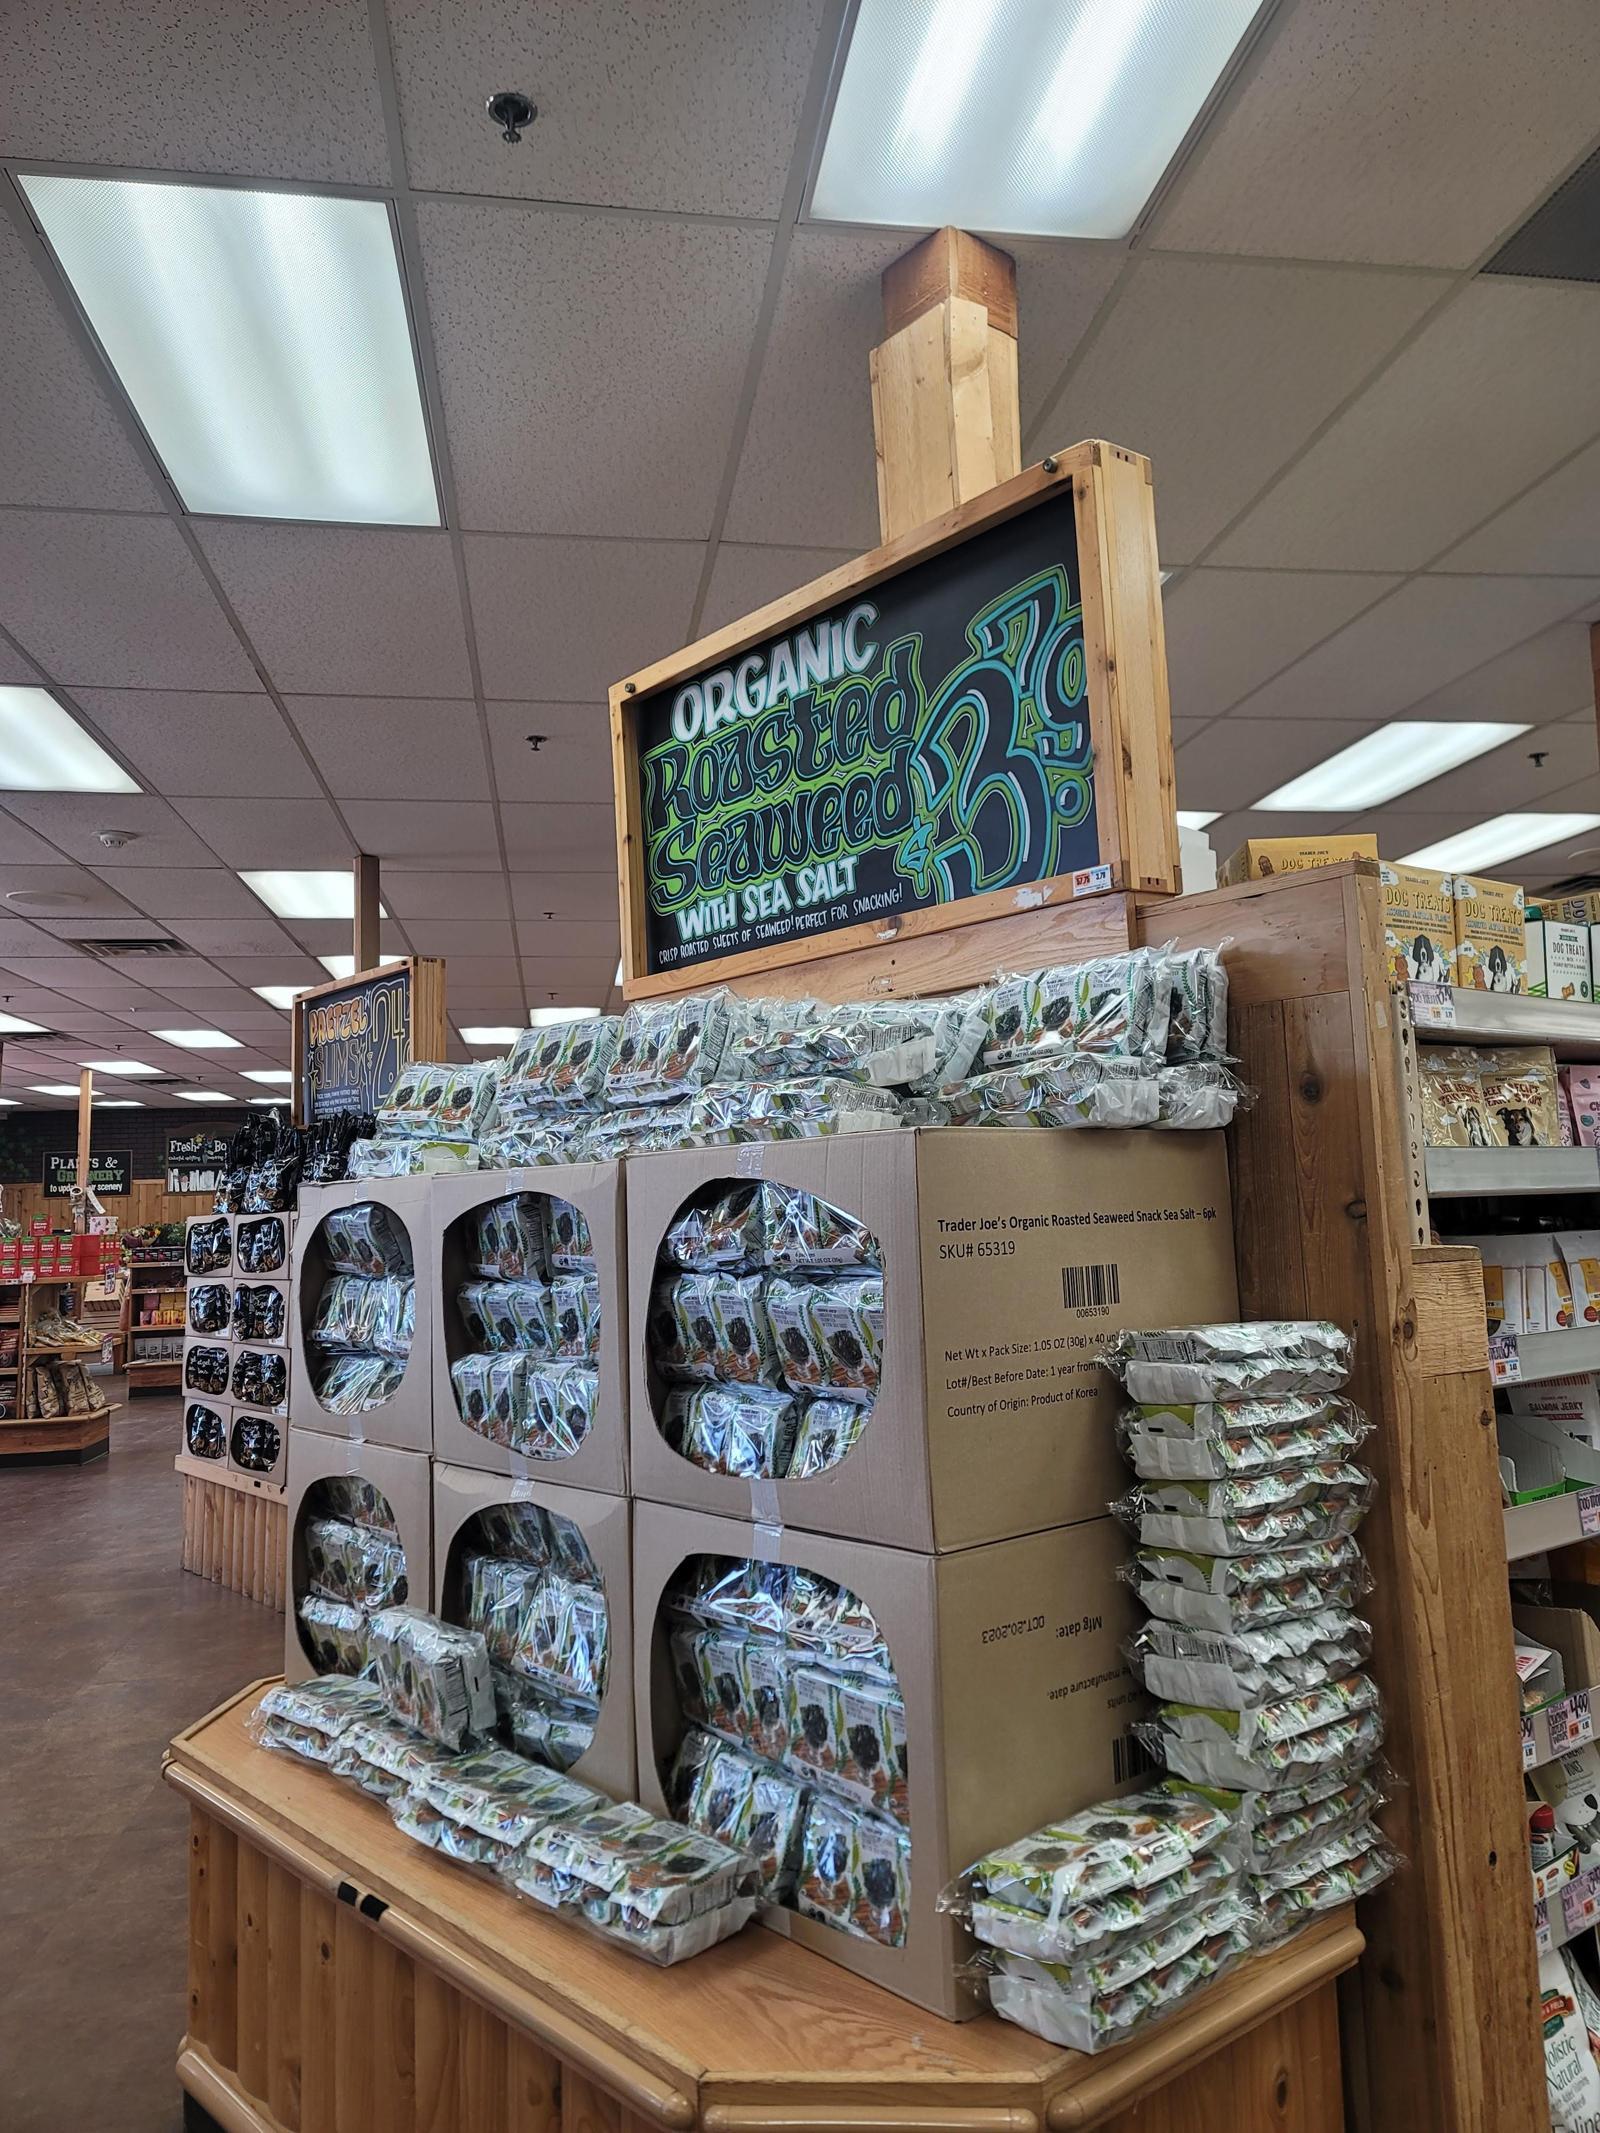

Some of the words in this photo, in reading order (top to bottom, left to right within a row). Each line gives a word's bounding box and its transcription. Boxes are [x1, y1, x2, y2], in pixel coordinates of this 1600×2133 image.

[670, 600, 880, 742] ORGANIC
[648, 640, 919, 833] Roasted
[654, 743, 914, 906] Seaweed
[675, 889, 737, 943] WITH
[743, 878, 792, 923] SEA
[797, 854, 859, 908] SALT
[1386, 887, 1408, 906] DOG
[1413, 892, 1451, 913] TREATS
[658, 947, 680, 965] CRISP
[680, 943, 709, 960] ROASTED
[713, 930, 739, 950] SHEETS
[741, 929, 751, 942] OF
[755, 919, 795, 939] SEAWEED!
[795, 911, 827, 930] PERFECT
[831, 904, 848, 921] FOR
[853, 882, 903, 916] SNACKING!
[1465, 900, 1486, 918] DOG
[1490, 904, 1522, 926] TREATS
[1552, 942, 1564, 954] DOG
[1565, 943, 1585, 957] TREATS
[308, 996, 369, 1048] PRETZEL
[316, 1038, 362, 1089] SLIMS
[170, 1138, 197, 1153] Fresh
[50, 1156, 99, 1169] PLAS
[105, 1156, 118, 1169] &
[57, 1169, 125, 1182] GRNERY
[49, 1184, 58, 1193] to
[97, 1183, 123, 1193] scenery
[938, 1218, 976, 1232] Trader
[980, 1216, 1007, 1230] Joe's
[1009, 1214, 1049, 1231] Organic
[1051, 1212, 1090, 1226] Roasted
[1093, 1210, 1134, 1224] Seaweed
[1137, 1208, 1162, 1222] Snack
[1163, 1208, 1179, 1221] Sea
[1180, 1207, 1195, 1220] Salt
[1203, 1207, 1217, 1221] 6pk
[939, 1243, 973, 1260] SKU#
[977, 1240, 1016, 1257] 65319
[1076, 1306, 1110, 1319] 00653190
[944, 1349, 962, 1362] Net
[964, 1348, 980, 1360] Wt
[981, 1350, 987, 1358] x
[989, 1345, 1010, 1357] Pack
[1011, 1342, 1032, 1354] Size:
[1034, 1340, 1051, 1352] 1.05
[1053, 1338, 1065, 1350] OZ
[1067, 1334, 1087, 1350] (30g)
[1095, 1333, 1105, 1344] 40
[946, 1374, 996, 1390] Lot#/Best
[994, 1370, 1024, 1384] Before
[1026, 1368, 1049, 1380] Date:
[1051, 1366, 1056, 1377] 1
[1057, 1364, 1075, 1380] year
[1077, 1361, 1100, 1374] from
[947, 1404, 985, 1418] Country
[987, 1401, 998, 1413] of
[999, 1397, 1029, 1411] Origin:
[1031, 1392, 1063, 1406] Product
[1065, 1389, 1075, 1400] of
[1075, 1386, 1098, 1399] Korea
[1528, 1402, 1559, 1412] SALMON
[1560, 1401, 1584, 1411] JERKY
[1055, 1620, 1082, 1639] date:
[1083, 1615, 1103, 1634] Mfg
[1070, 1666, 1120, 1694] manufacture
